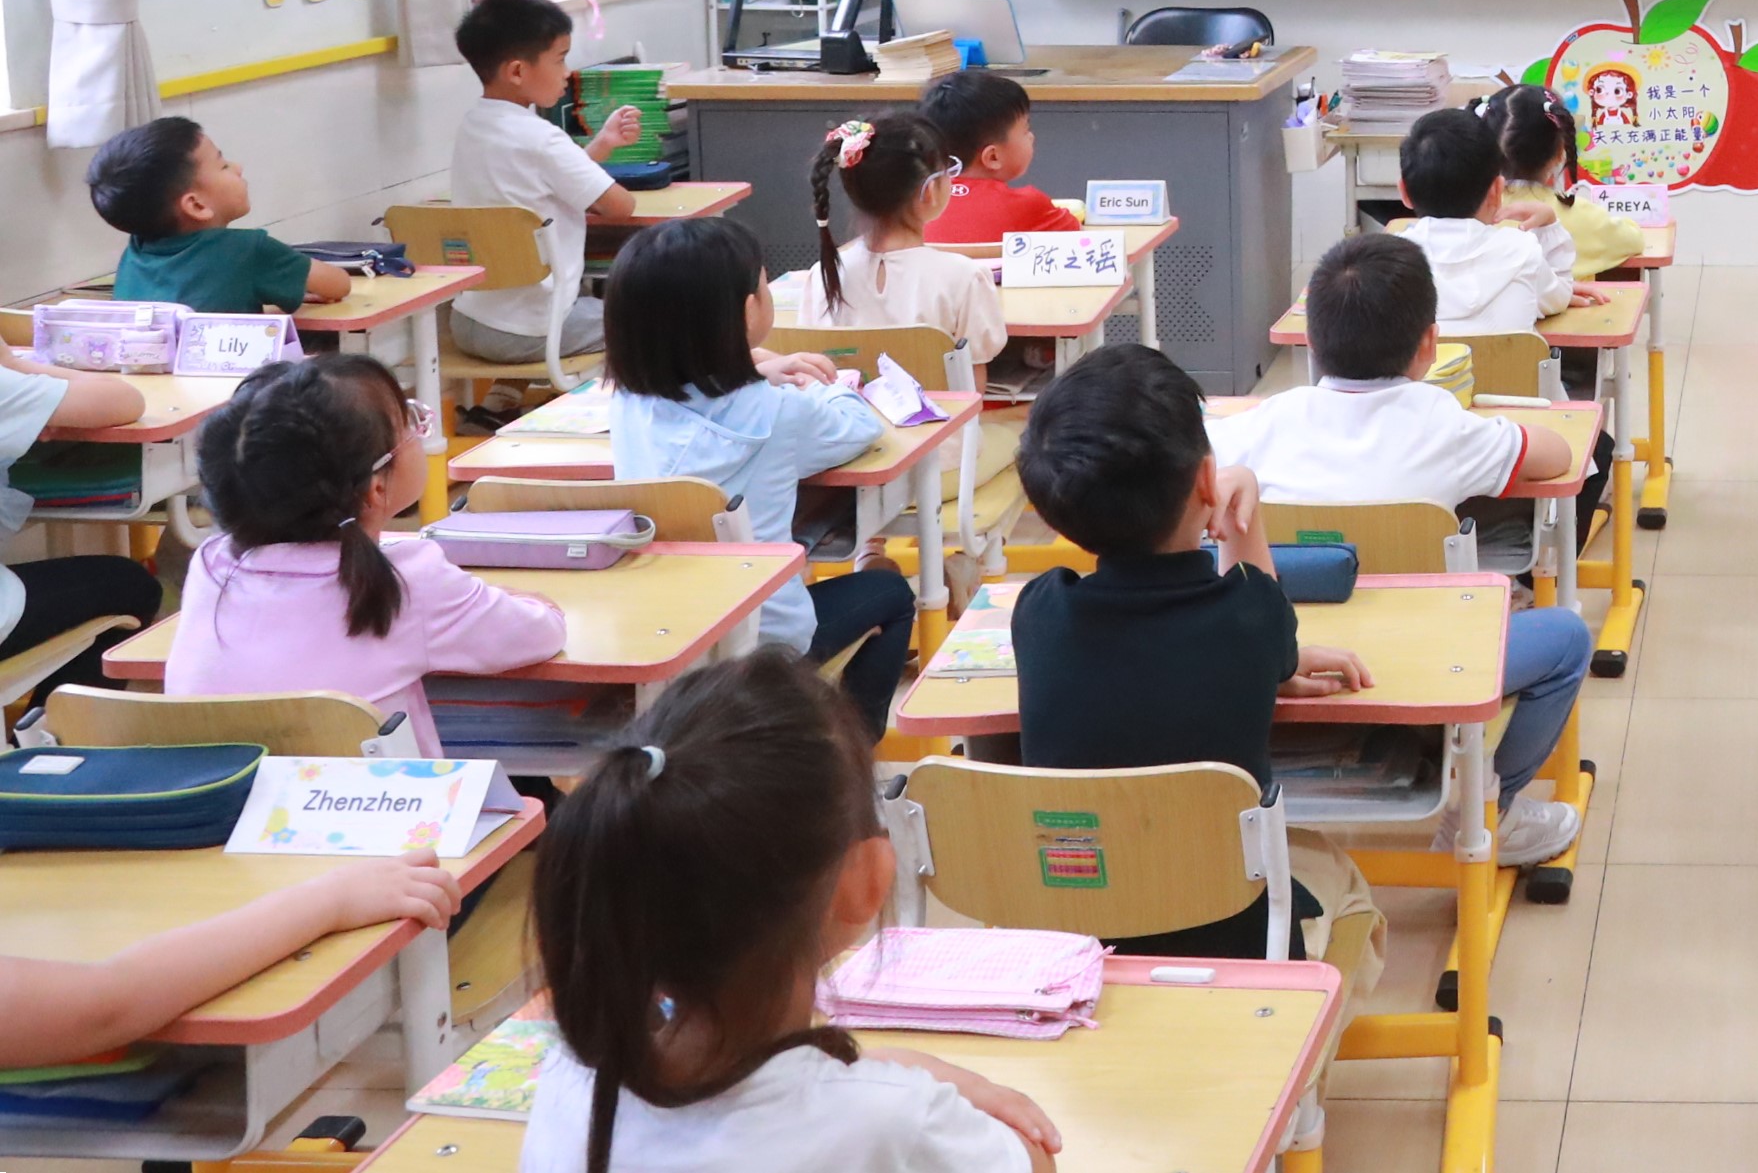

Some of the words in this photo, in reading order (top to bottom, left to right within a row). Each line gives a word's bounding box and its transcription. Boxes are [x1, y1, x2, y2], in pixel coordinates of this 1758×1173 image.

[1646, 84, 1710, 100] 我是一个
[1649, 106, 1695, 120] 小太阳
[1594, 127, 1703, 145] 天天充满正能量
[1100, 197, 1121, 208] Eric
[1125, 197, 1149, 208] Sun
[1599, 190, 1609, 201] 4
[1607, 201, 1651, 213] FREYA
[218, 336, 248, 355] Lily
[303, 789, 422, 812] Zhenzhen
